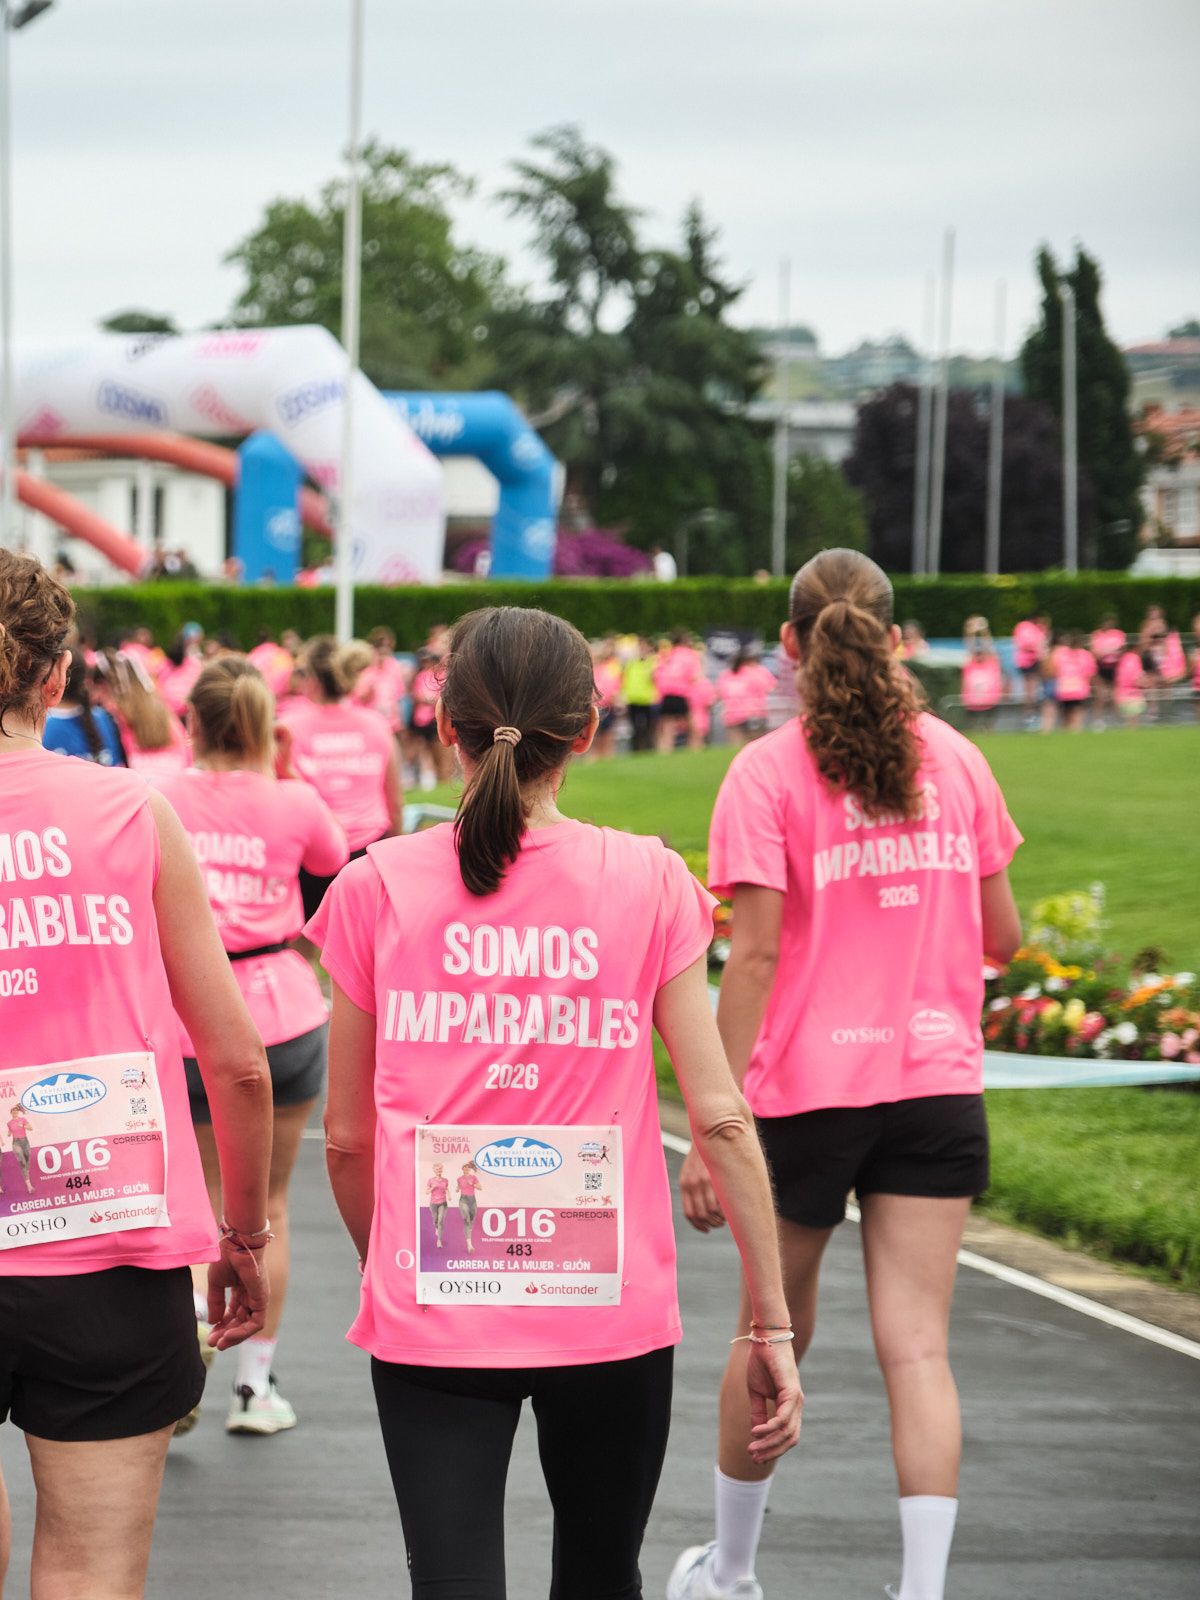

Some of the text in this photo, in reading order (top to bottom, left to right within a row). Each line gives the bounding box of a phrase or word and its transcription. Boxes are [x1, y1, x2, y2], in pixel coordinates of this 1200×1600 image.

[187, 831, 267, 870] OMOS
[813, 831, 973, 891] IMPARABLES
[879, 884, 920, 908] 2026
[442, 921, 599, 980] SOMOS
[383, 989, 639, 1049] IMPARABLES
[484, 1063, 539, 1090] 2026
[29, 1087, 101, 1107] ASTURIANA
[113, 1134, 162, 1145] CORREDORA
[433, 1143, 471, 1154] SUMA
[37, 1138, 111, 1175] 016
[482, 1152, 556, 1168] ASTURIANA
[65, 1175, 92, 1189] 484
[10, 1197, 53, 1213] CARRERA
[54, 1195, 67, 1206] DE
[69, 1193, 82, 1204] LA
[83, 1187, 115, 1201] MUJER
[123, 1181, 150, 1195] GIJÓN
[7, 1205, 159, 1237] OYSHO Santander
[481, 1208, 556, 1238] 016
[560, 1211, 615, 1219] CORREDORA
[506, 1243, 533, 1256] 483
[446, 1260, 490, 1270] CARRERA
[492, 1260, 505, 1270] DE
[507, 1260, 520, 1270] LA
[522, 1260, 554, 1271] MUJER
[563, 1258, 591, 1271] GIJÓN
[439, 1280, 599, 1295] OYSHO Santander
